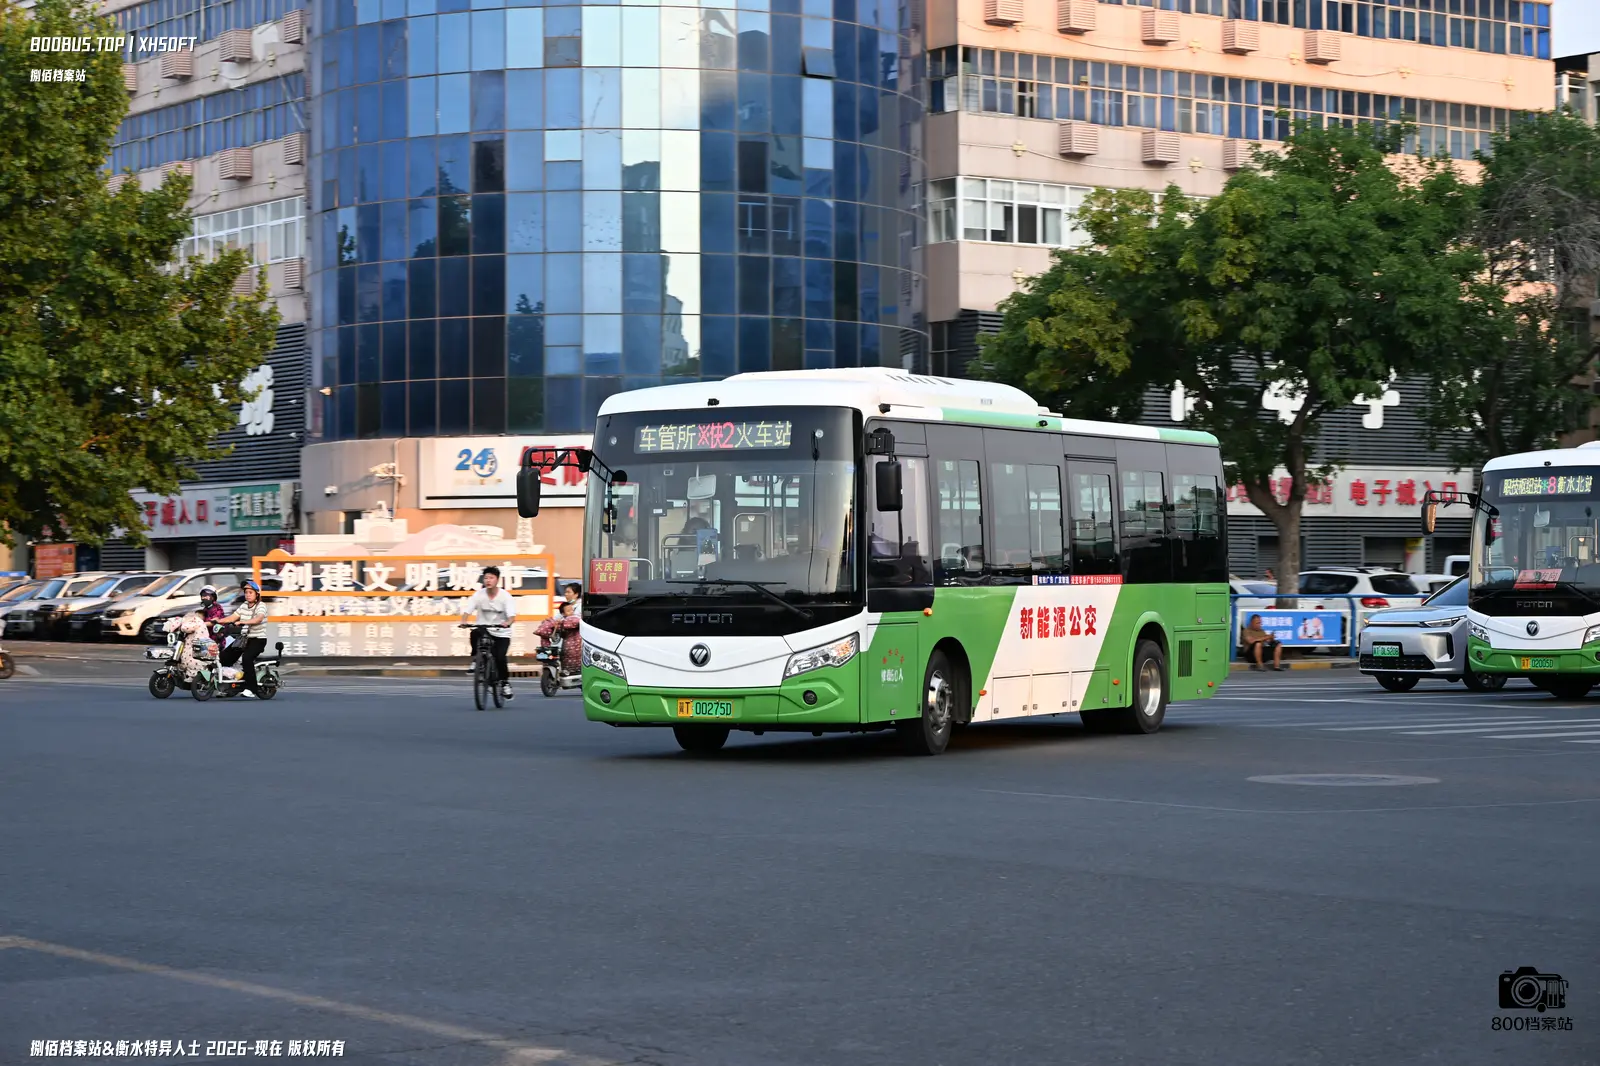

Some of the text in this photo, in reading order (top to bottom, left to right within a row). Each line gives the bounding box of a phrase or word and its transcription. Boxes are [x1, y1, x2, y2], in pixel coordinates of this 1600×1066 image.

[1349, 478, 1458, 506] 电子城入口
[595, 562, 623, 572] 大庆路
[279, 561, 522, 592] 创建文明城市
[599, 573, 617, 582] 直行
[1516, 600, 1553, 608] FOTON
[671, 613, 733, 624] FOTON
[1020, 604, 1097, 640] 新能源公交
[364, 623, 394, 638] 自由
